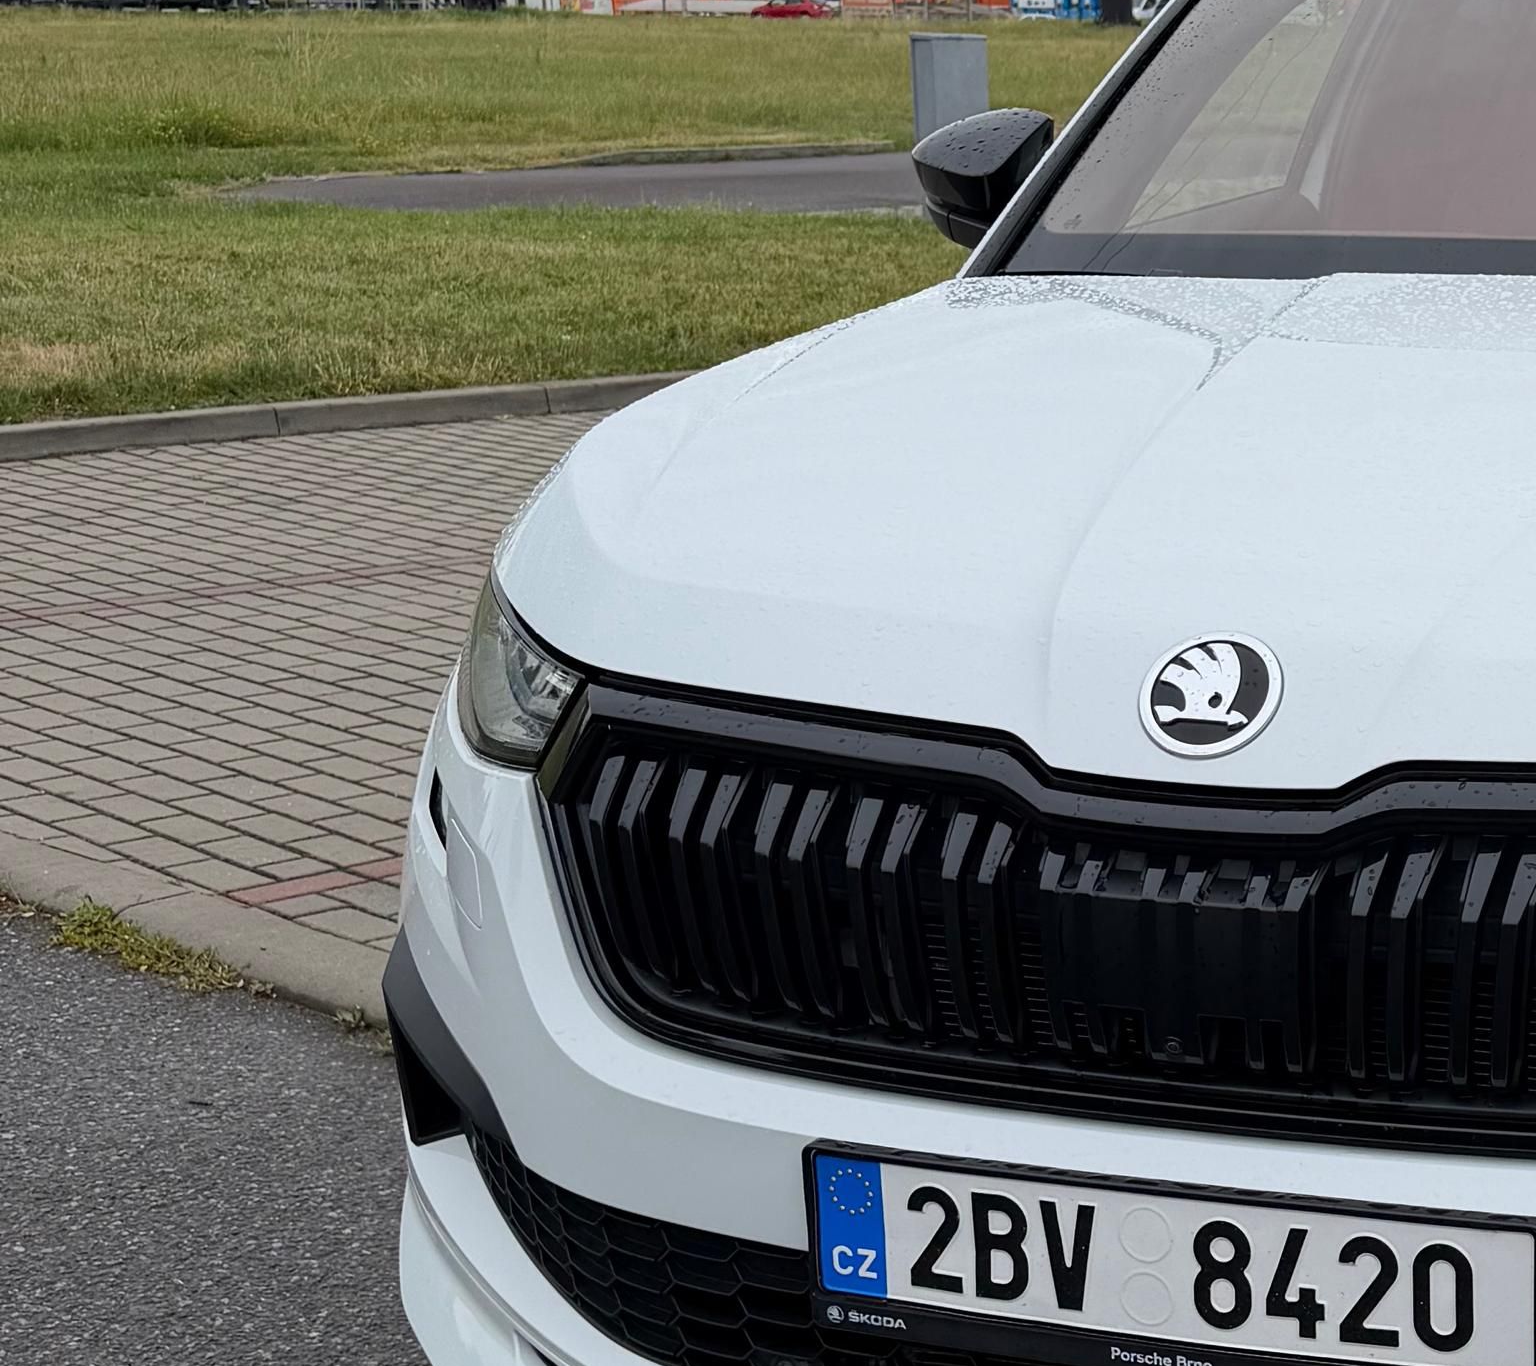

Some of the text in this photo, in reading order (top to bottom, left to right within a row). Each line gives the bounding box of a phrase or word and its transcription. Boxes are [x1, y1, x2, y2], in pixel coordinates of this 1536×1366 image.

[832, 1245, 878, 1280] CZ
[906, 1186, 1475, 1353] 2BV 8420
[848, 1310, 907, 1330] ŠKODA
